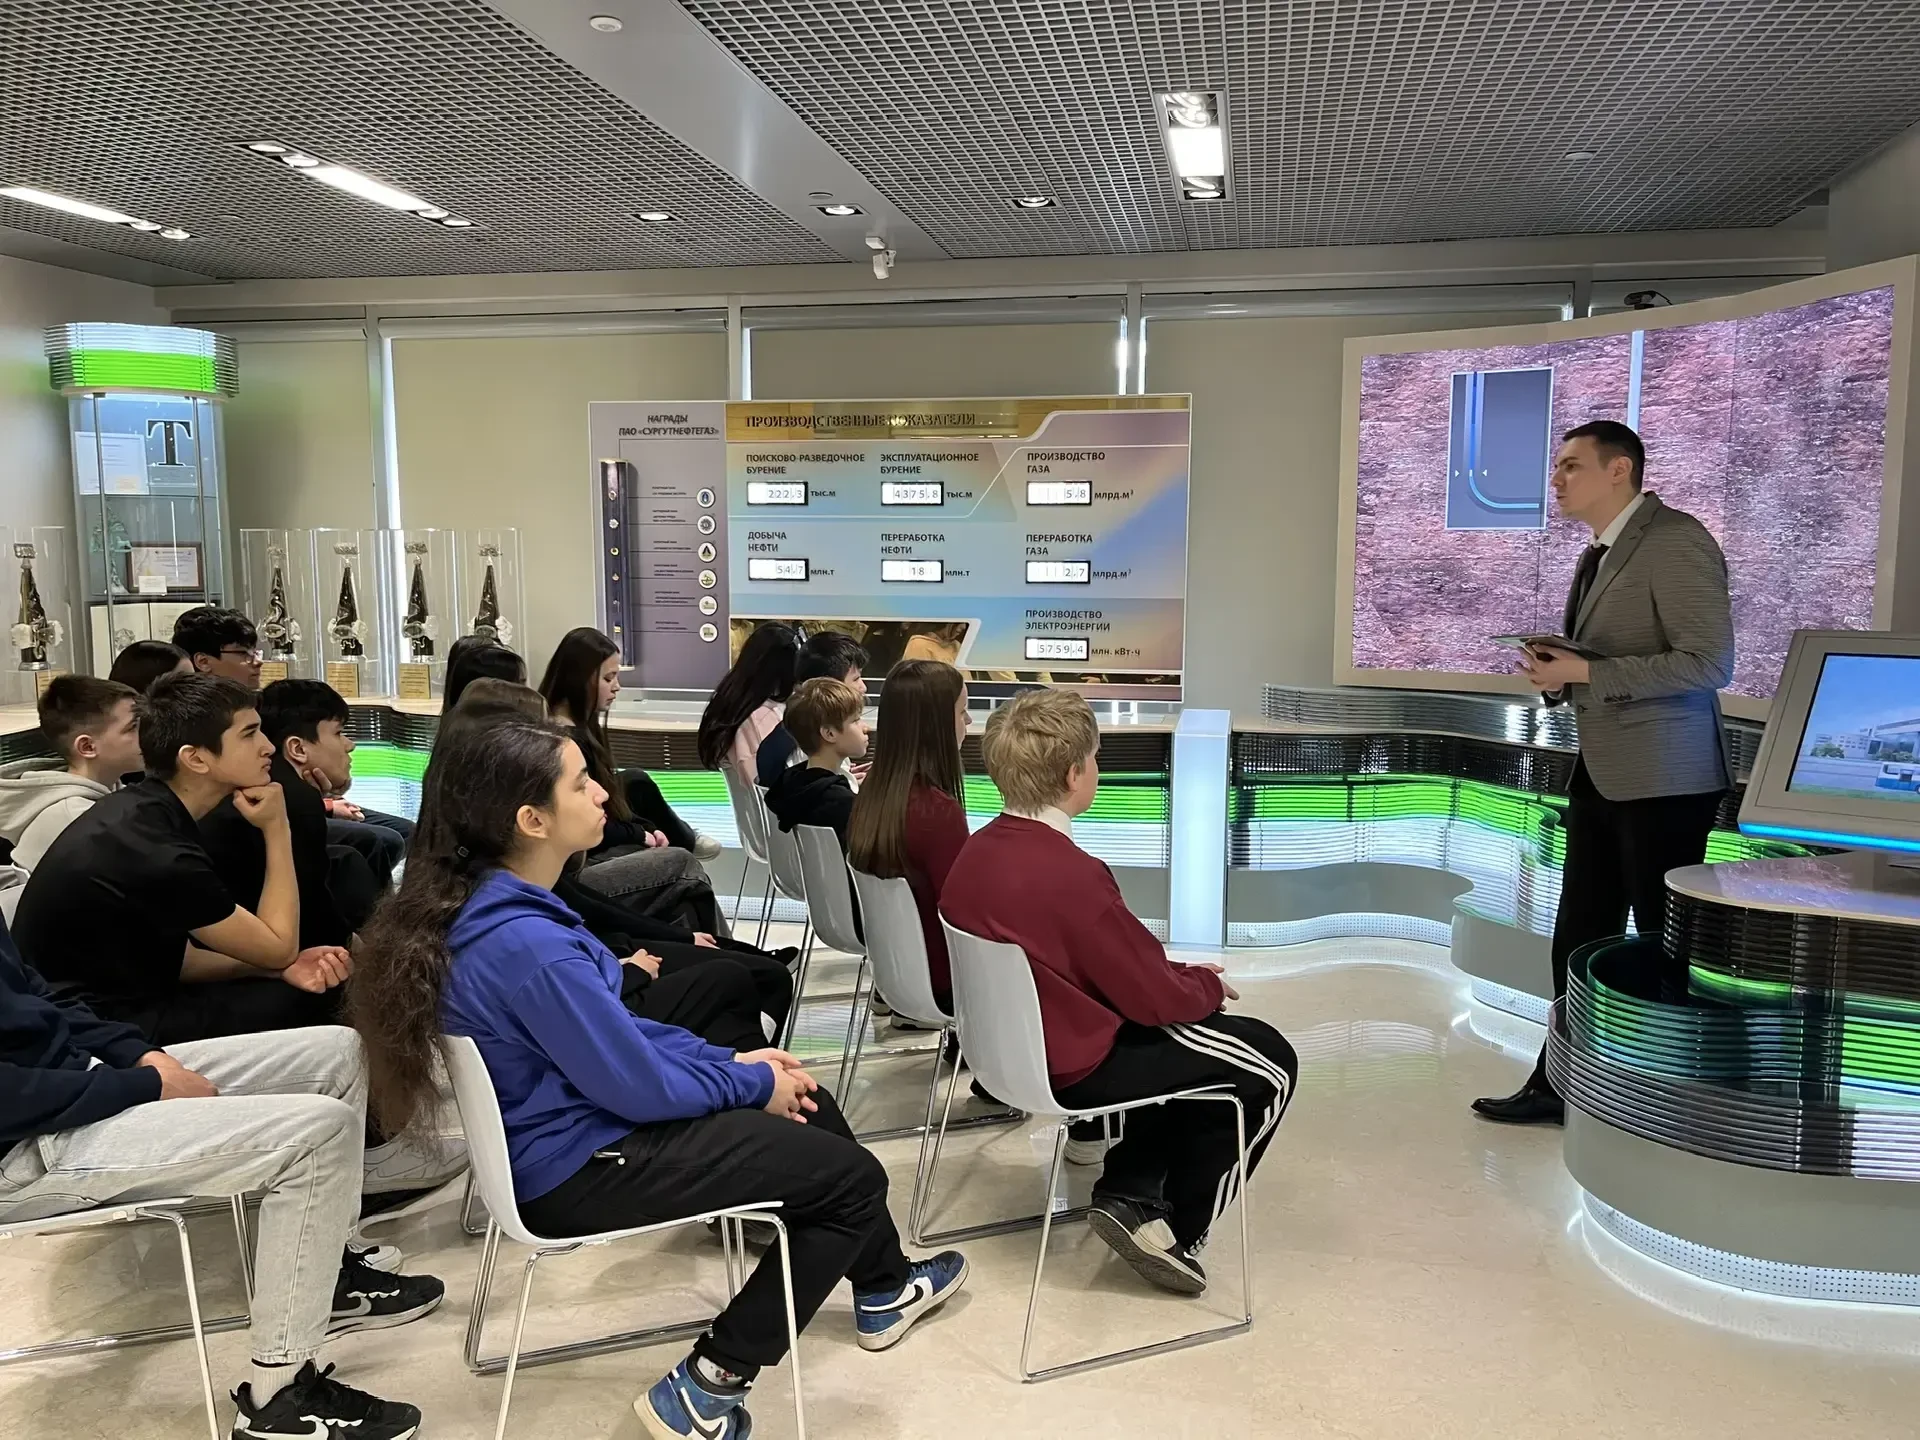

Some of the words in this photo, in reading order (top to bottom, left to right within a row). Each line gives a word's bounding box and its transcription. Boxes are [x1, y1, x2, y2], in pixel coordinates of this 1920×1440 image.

[647, 415, 688, 424] НАГРАДЫ
[746, 414, 886, 428] ПРОИЗВОДСТВЕННЫЕ
[619, 427, 637, 436] ПАО
[880, 453, 979, 462] ЭКСПЛУАТАЦИОННОЕ
[1027, 452, 1106, 462] ПРОИЗВОДСТВО
[746, 466, 786, 474] БУРЕНИЕ
[880, 466, 921, 474] БУРЕНИЕ
[1027, 465, 1050, 473] ГАЗА
[748, 531, 787, 540] ДОБЫЧА
[881, 534, 945, 542] ПЕРЕРАБОТКА
[1026, 534, 1093, 543] ПЕРЕРАБОТКА
[748, 544, 778, 552] НЕФТИ
[881, 546, 912, 554] НЕФТИ
[1026, 547, 1048, 555] ГАЗА
[1025, 609, 1102, 619] ПРОИЗВОДСТВО
[1025, 622, 1111, 631] ЭЛЕКТРОЭНЕРГИИ
